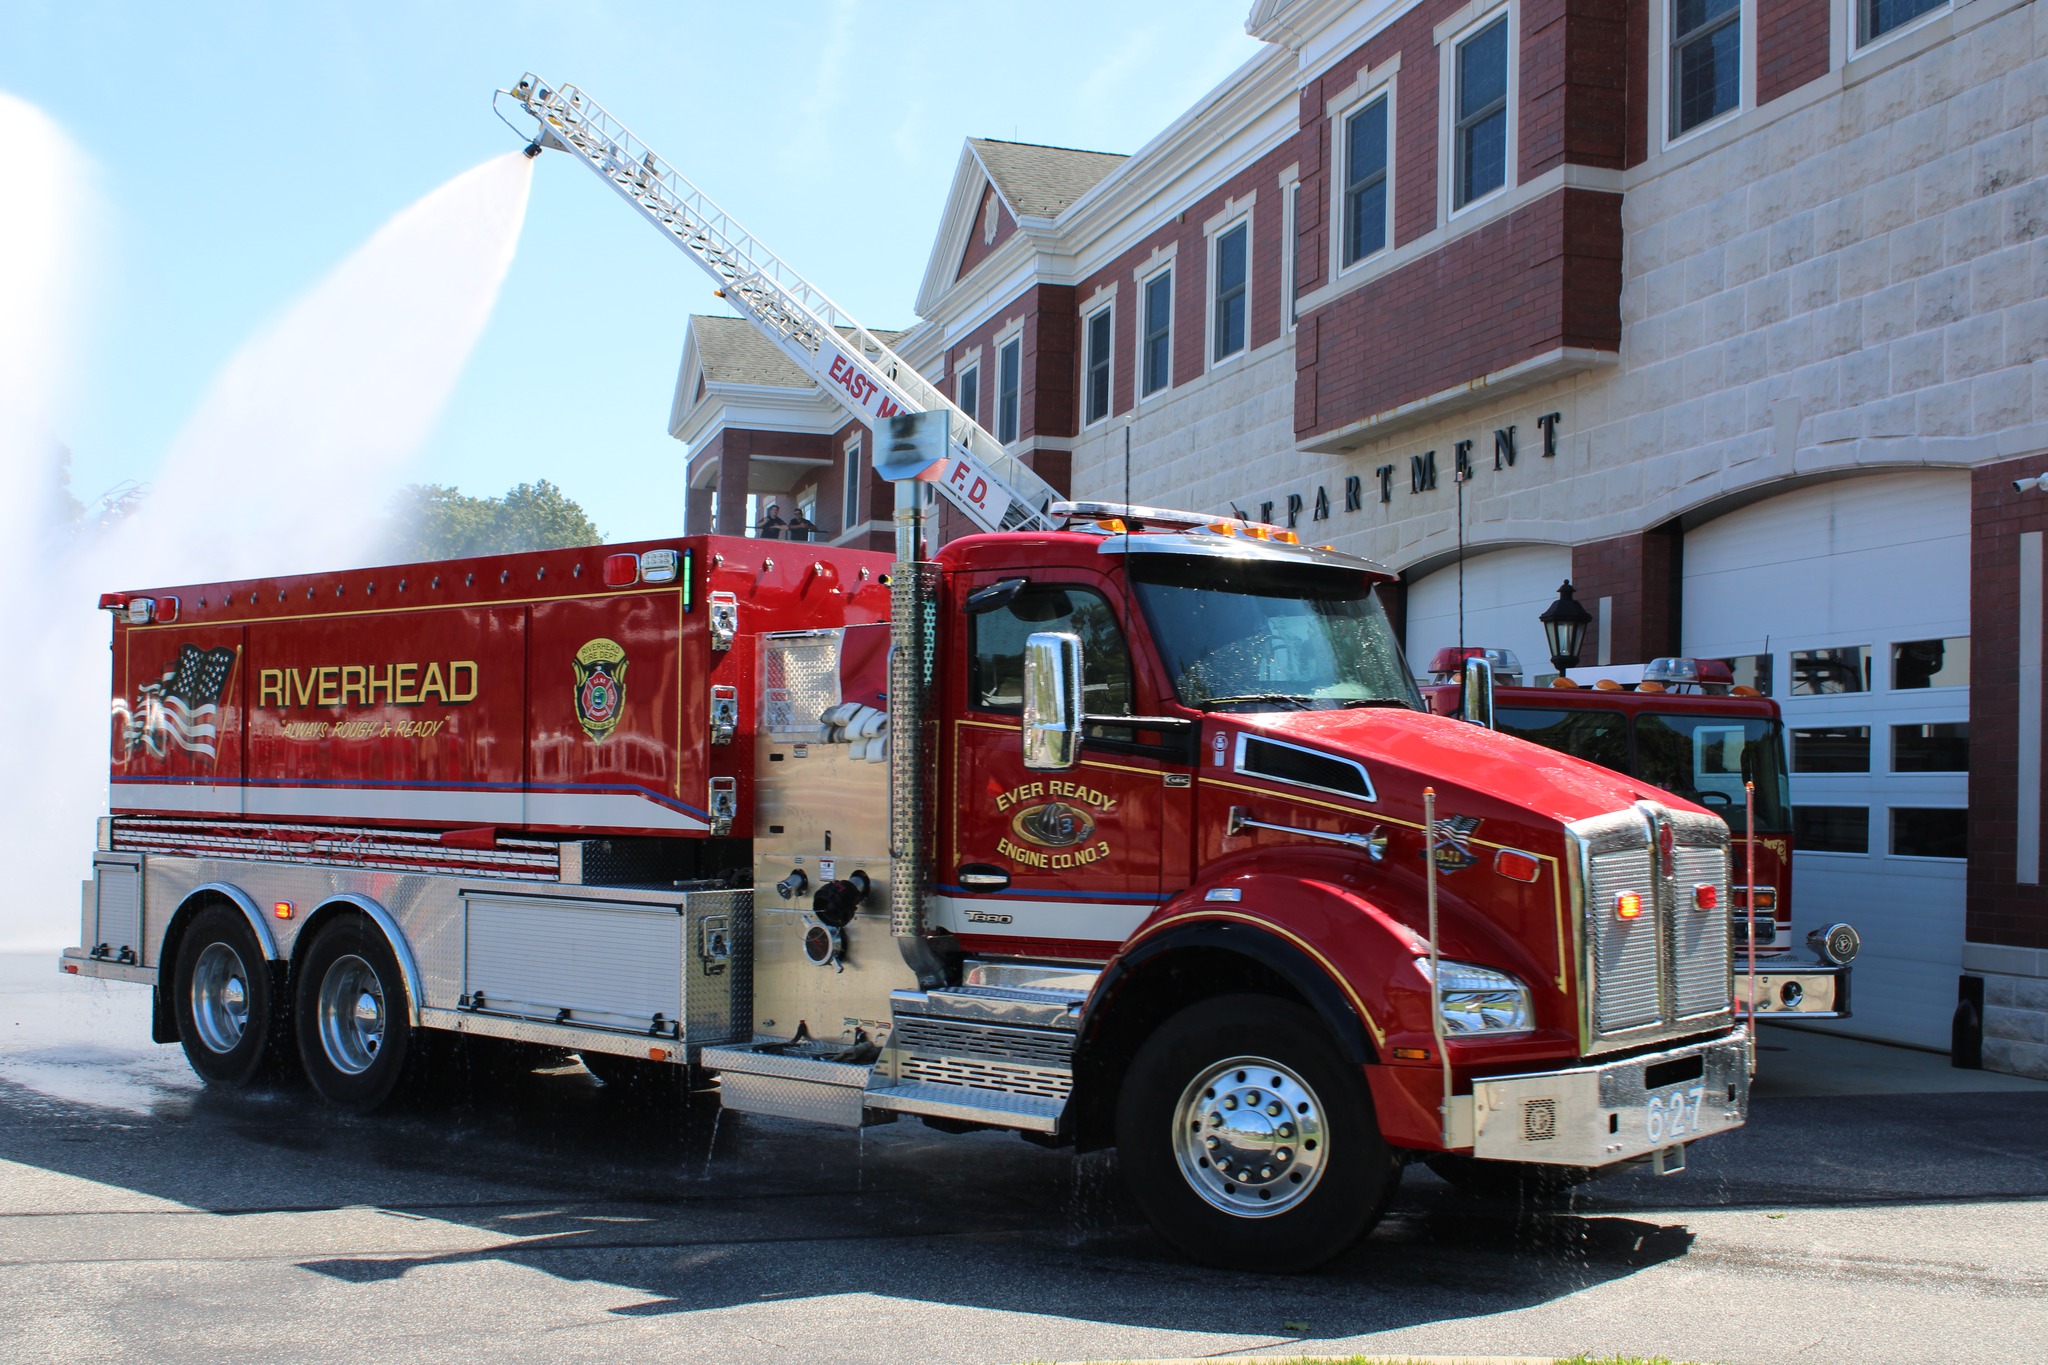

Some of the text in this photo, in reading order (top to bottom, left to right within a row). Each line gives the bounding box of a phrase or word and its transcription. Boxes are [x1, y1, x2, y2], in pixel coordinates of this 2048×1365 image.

[828, 354, 878, 406] EAST
[581, 642, 620, 655] RIVERHEAD
[582, 650, 617, 663] FIRE DEPT
[258, 660, 479, 708] RIVERHEAD
[332, 721, 379, 738] ROUGH
[380, 721, 393, 738] &
[996, 780, 1118, 812] EVER READY
[1061, 817, 1073, 834] 3
[996, 837, 1049, 869] ENGINE
[964, 910, 1013, 924] T880
